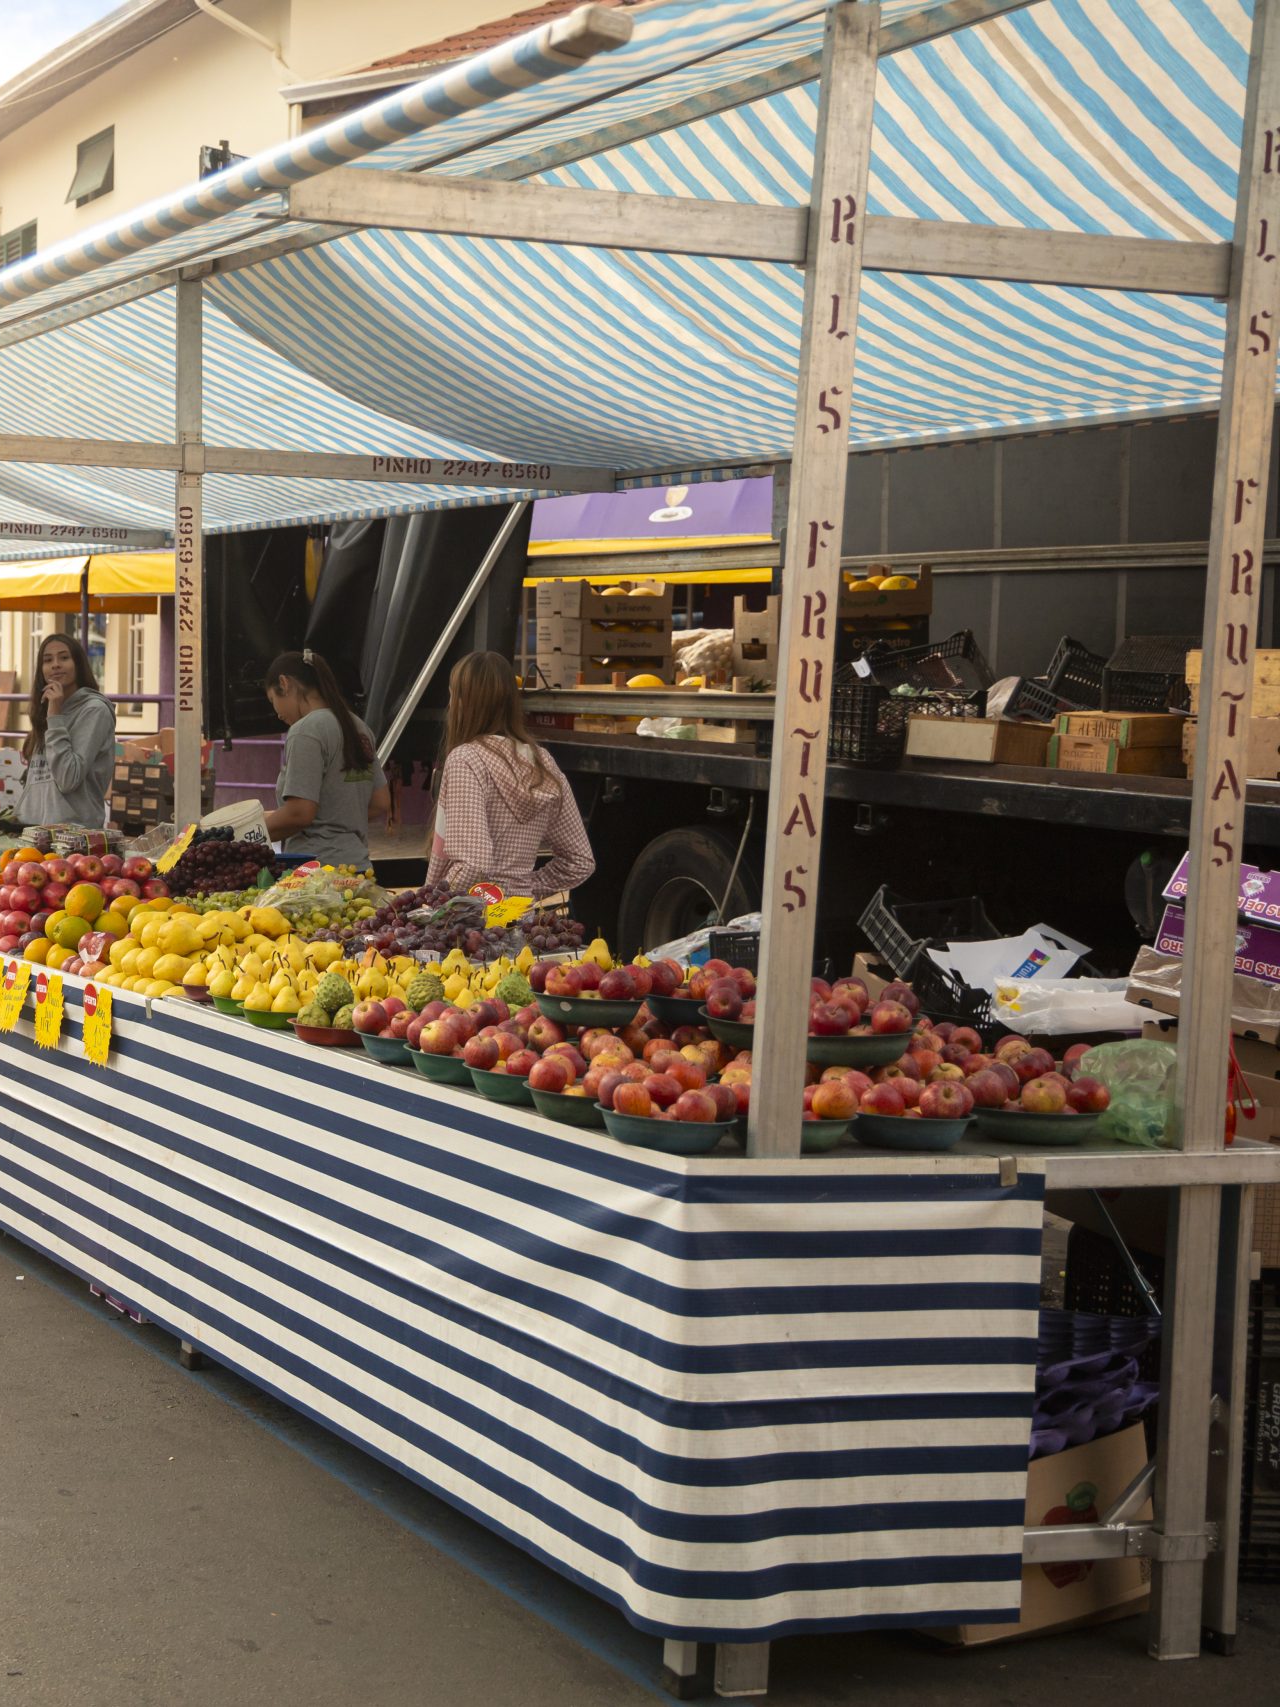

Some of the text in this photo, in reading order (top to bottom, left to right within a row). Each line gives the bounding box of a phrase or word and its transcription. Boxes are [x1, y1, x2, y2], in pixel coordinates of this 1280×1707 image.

[0, 522, 128, 540] PINHO 2747-6560
[373, 457, 551, 480] PINHO 2747-6560
[179, 506, 194, 711] PINHO 2747-6560
[1211, 478, 1258, 868] FRUTAS
[782, 520, 835, 914] FRUTAS
